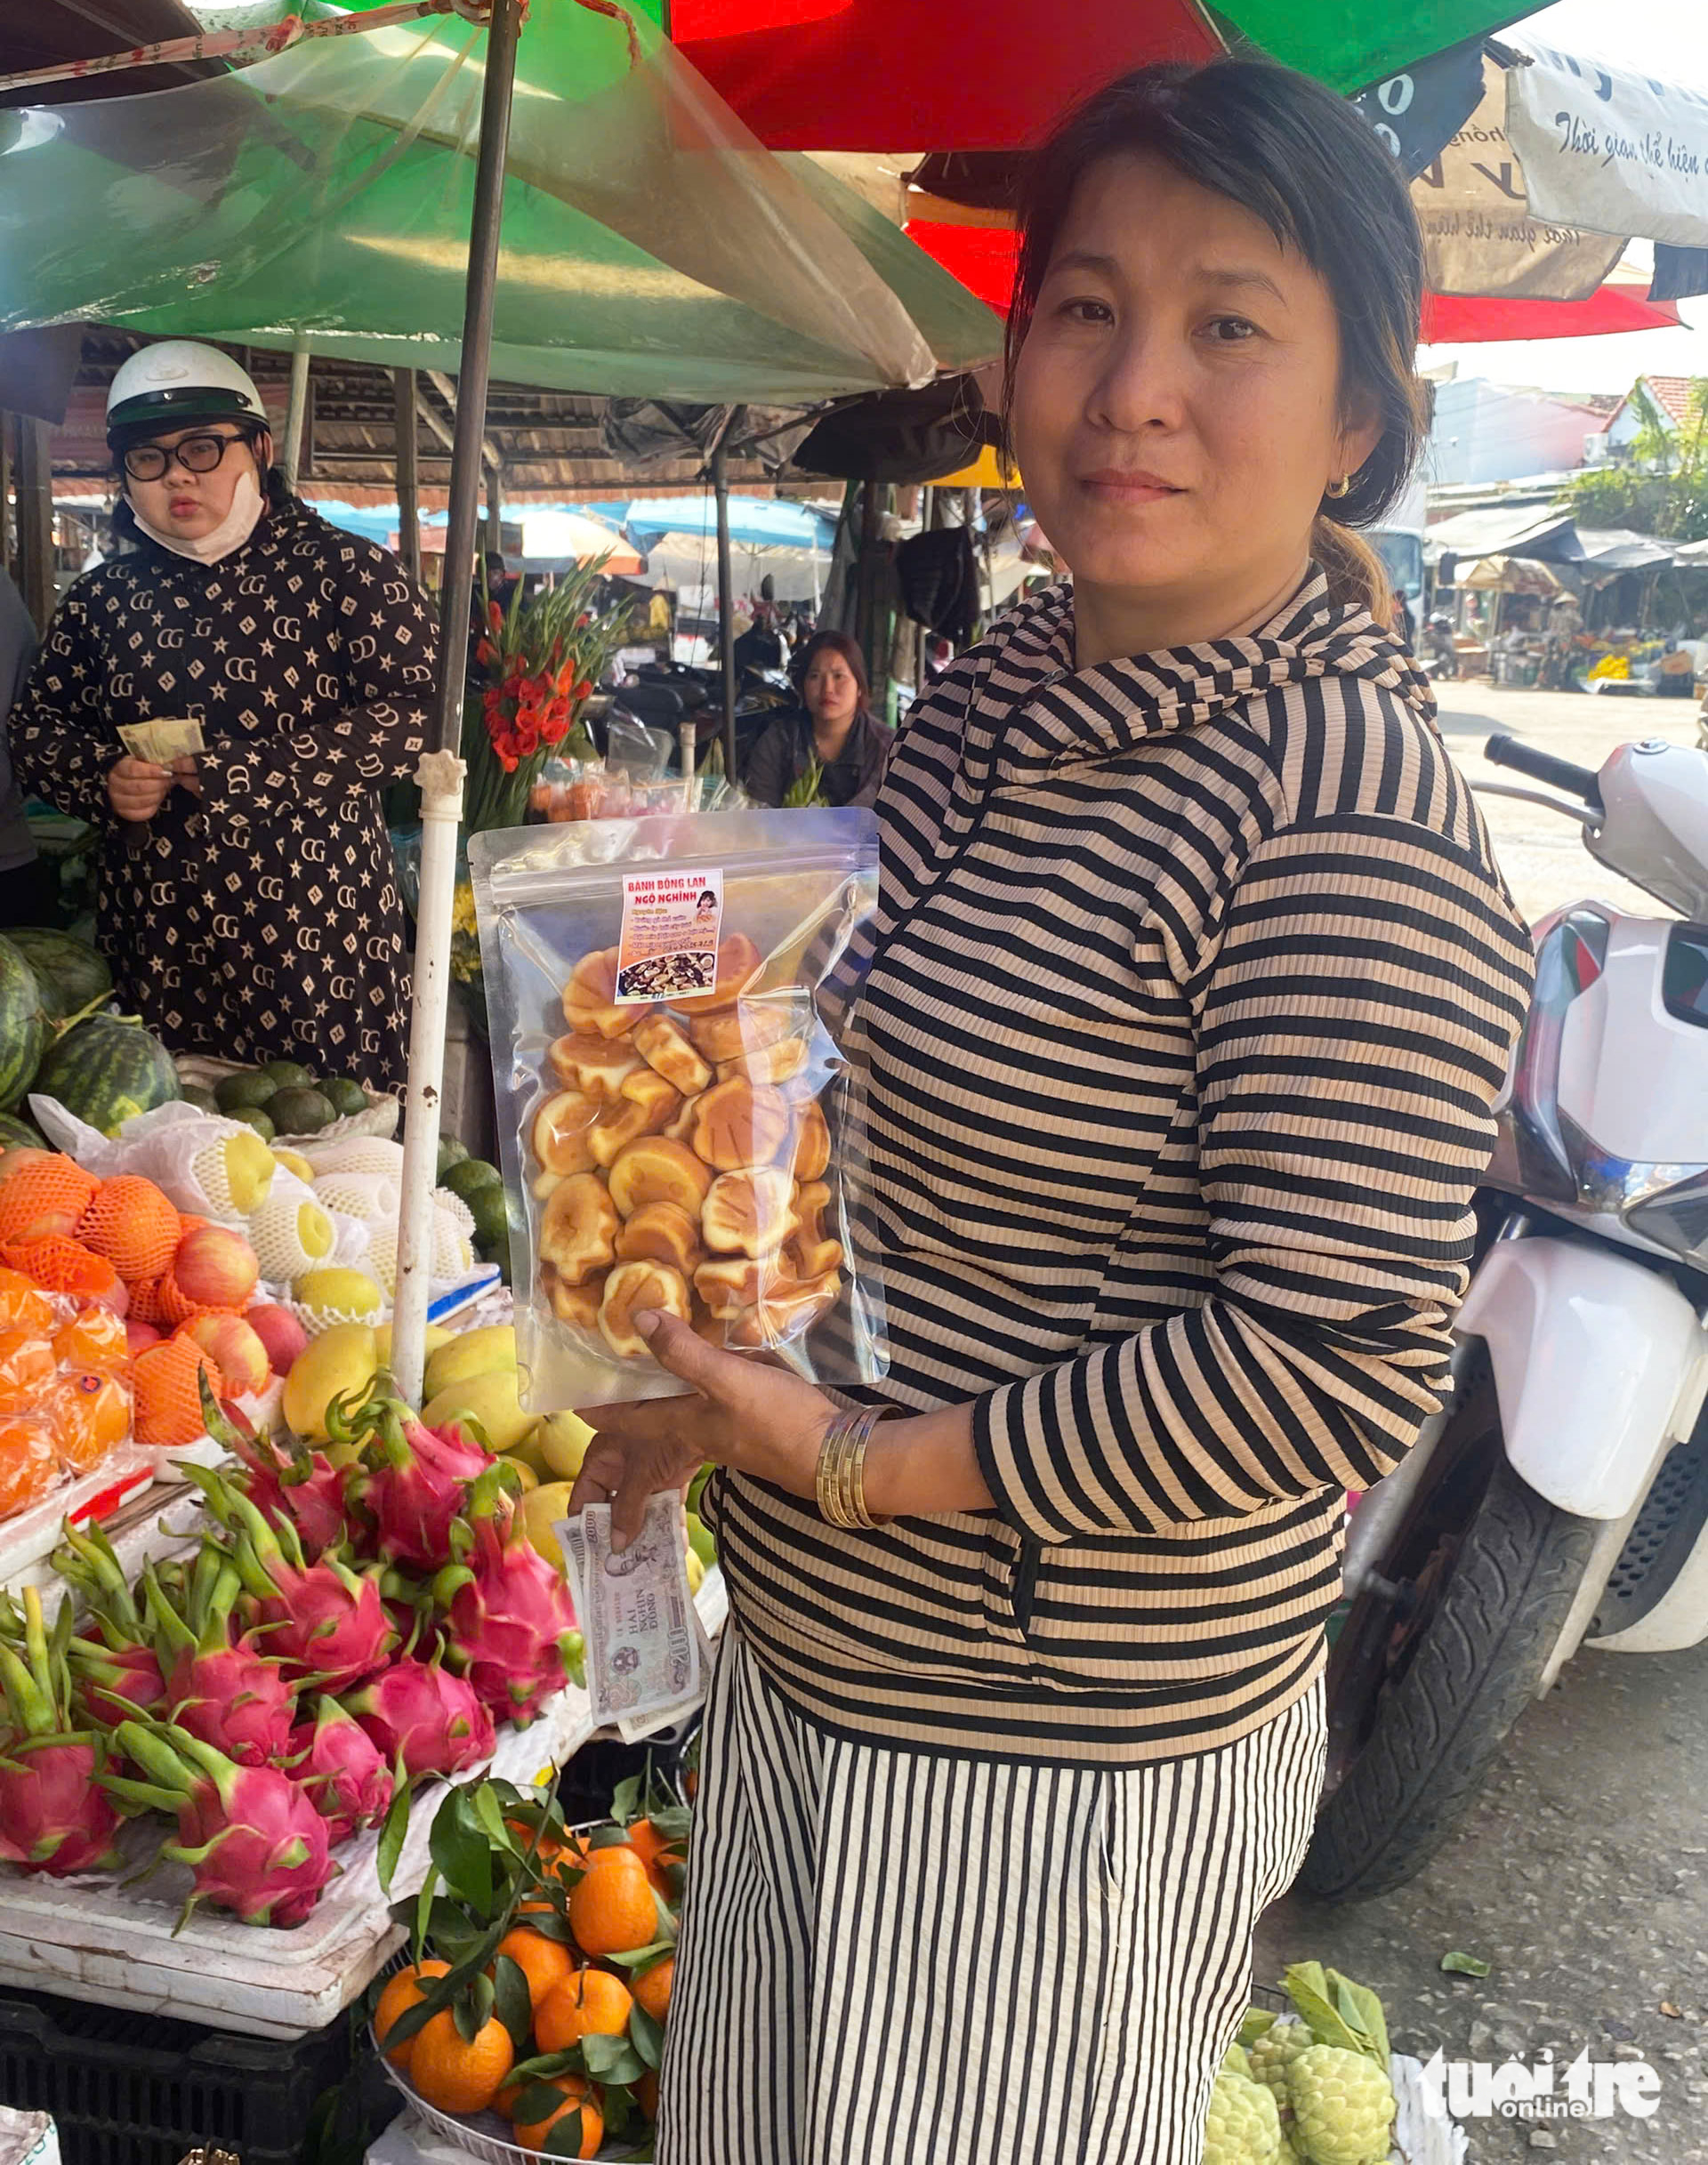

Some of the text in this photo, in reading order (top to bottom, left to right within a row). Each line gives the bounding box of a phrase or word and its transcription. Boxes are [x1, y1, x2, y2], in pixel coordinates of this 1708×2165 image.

[1555, 111, 1599, 155] Thời
[1601, 133, 1639, 168] gian
[687, 876, 706, 888] LAN
[627, 1609, 639, 1635] HAI
[668, 1625, 691, 1668] 2000
